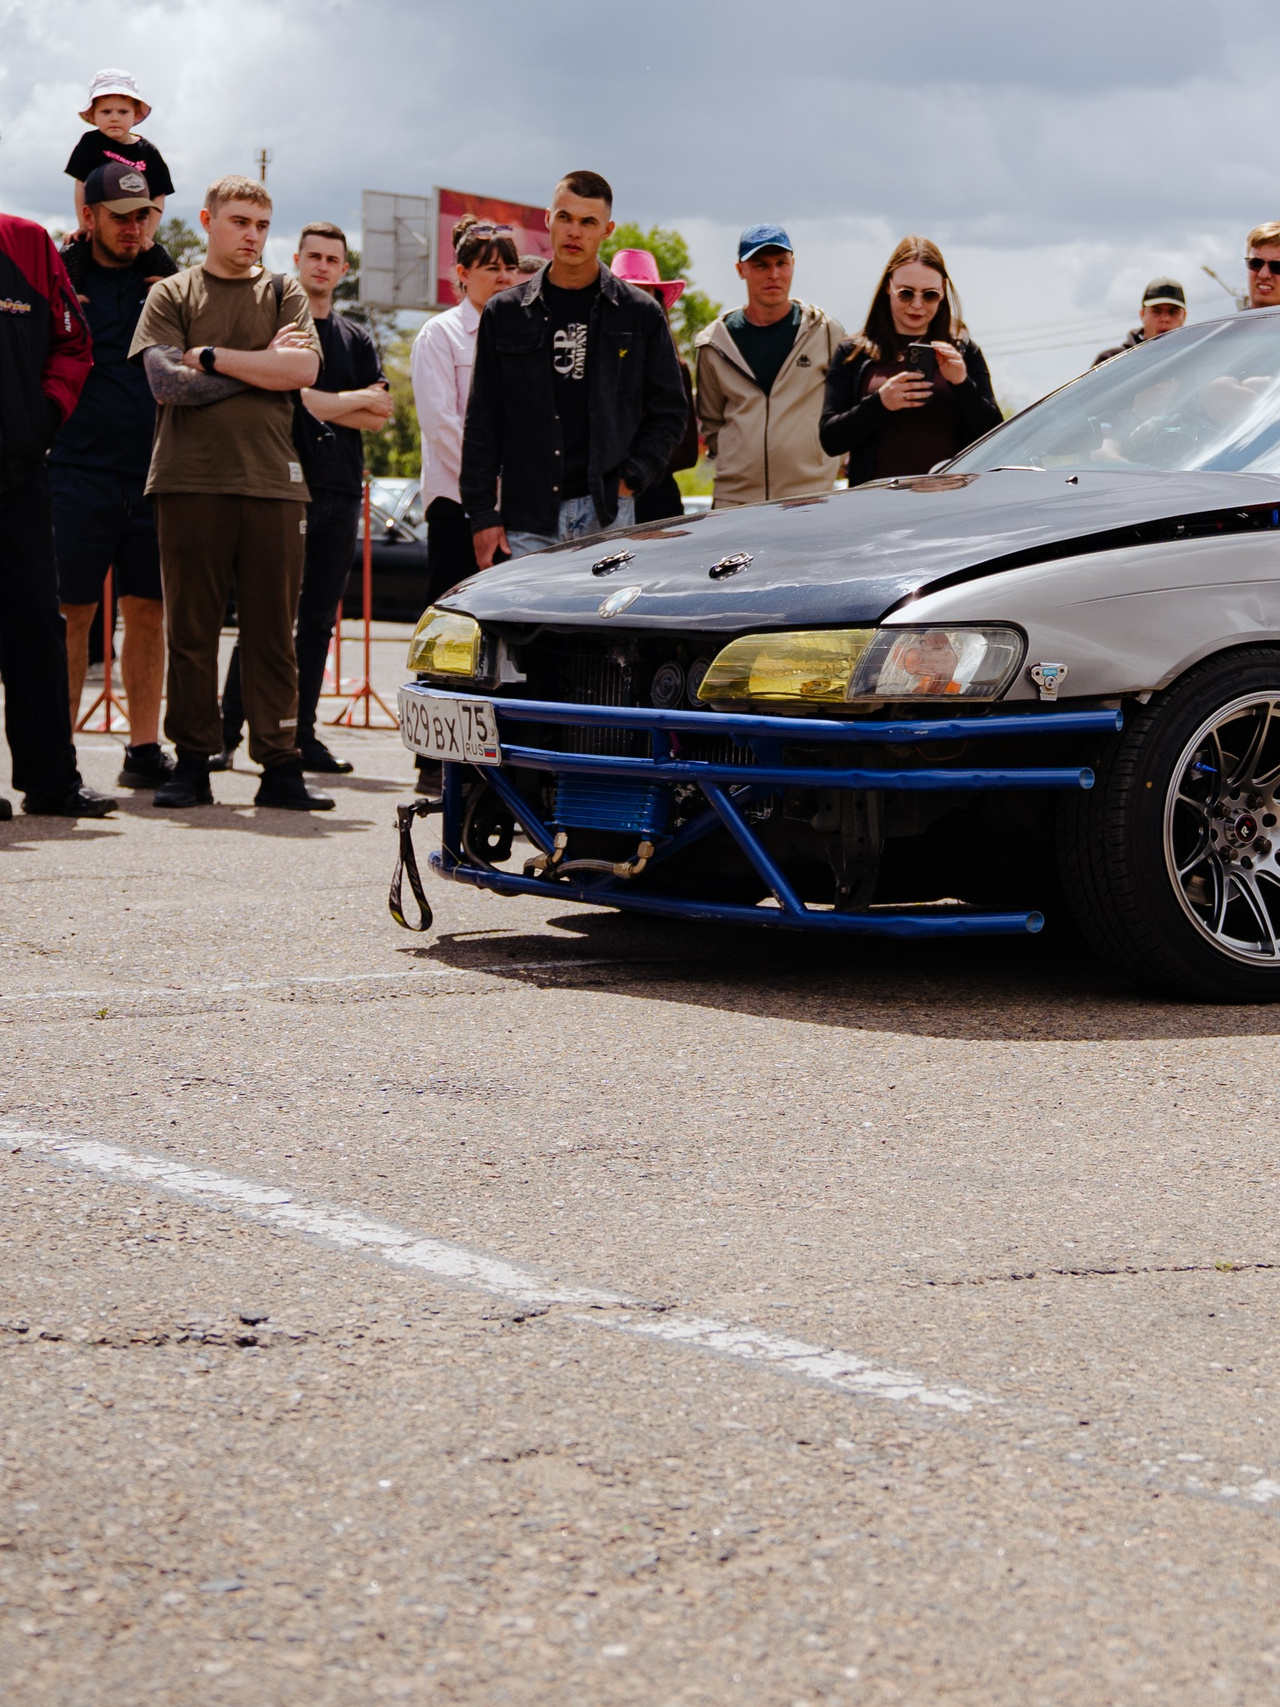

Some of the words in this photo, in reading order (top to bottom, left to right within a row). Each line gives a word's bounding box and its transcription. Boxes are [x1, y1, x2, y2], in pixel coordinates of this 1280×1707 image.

[572, 323, 588, 380] COMPANY
[462, 706, 488, 742] 75
[465, 742, 484, 756] RUS
